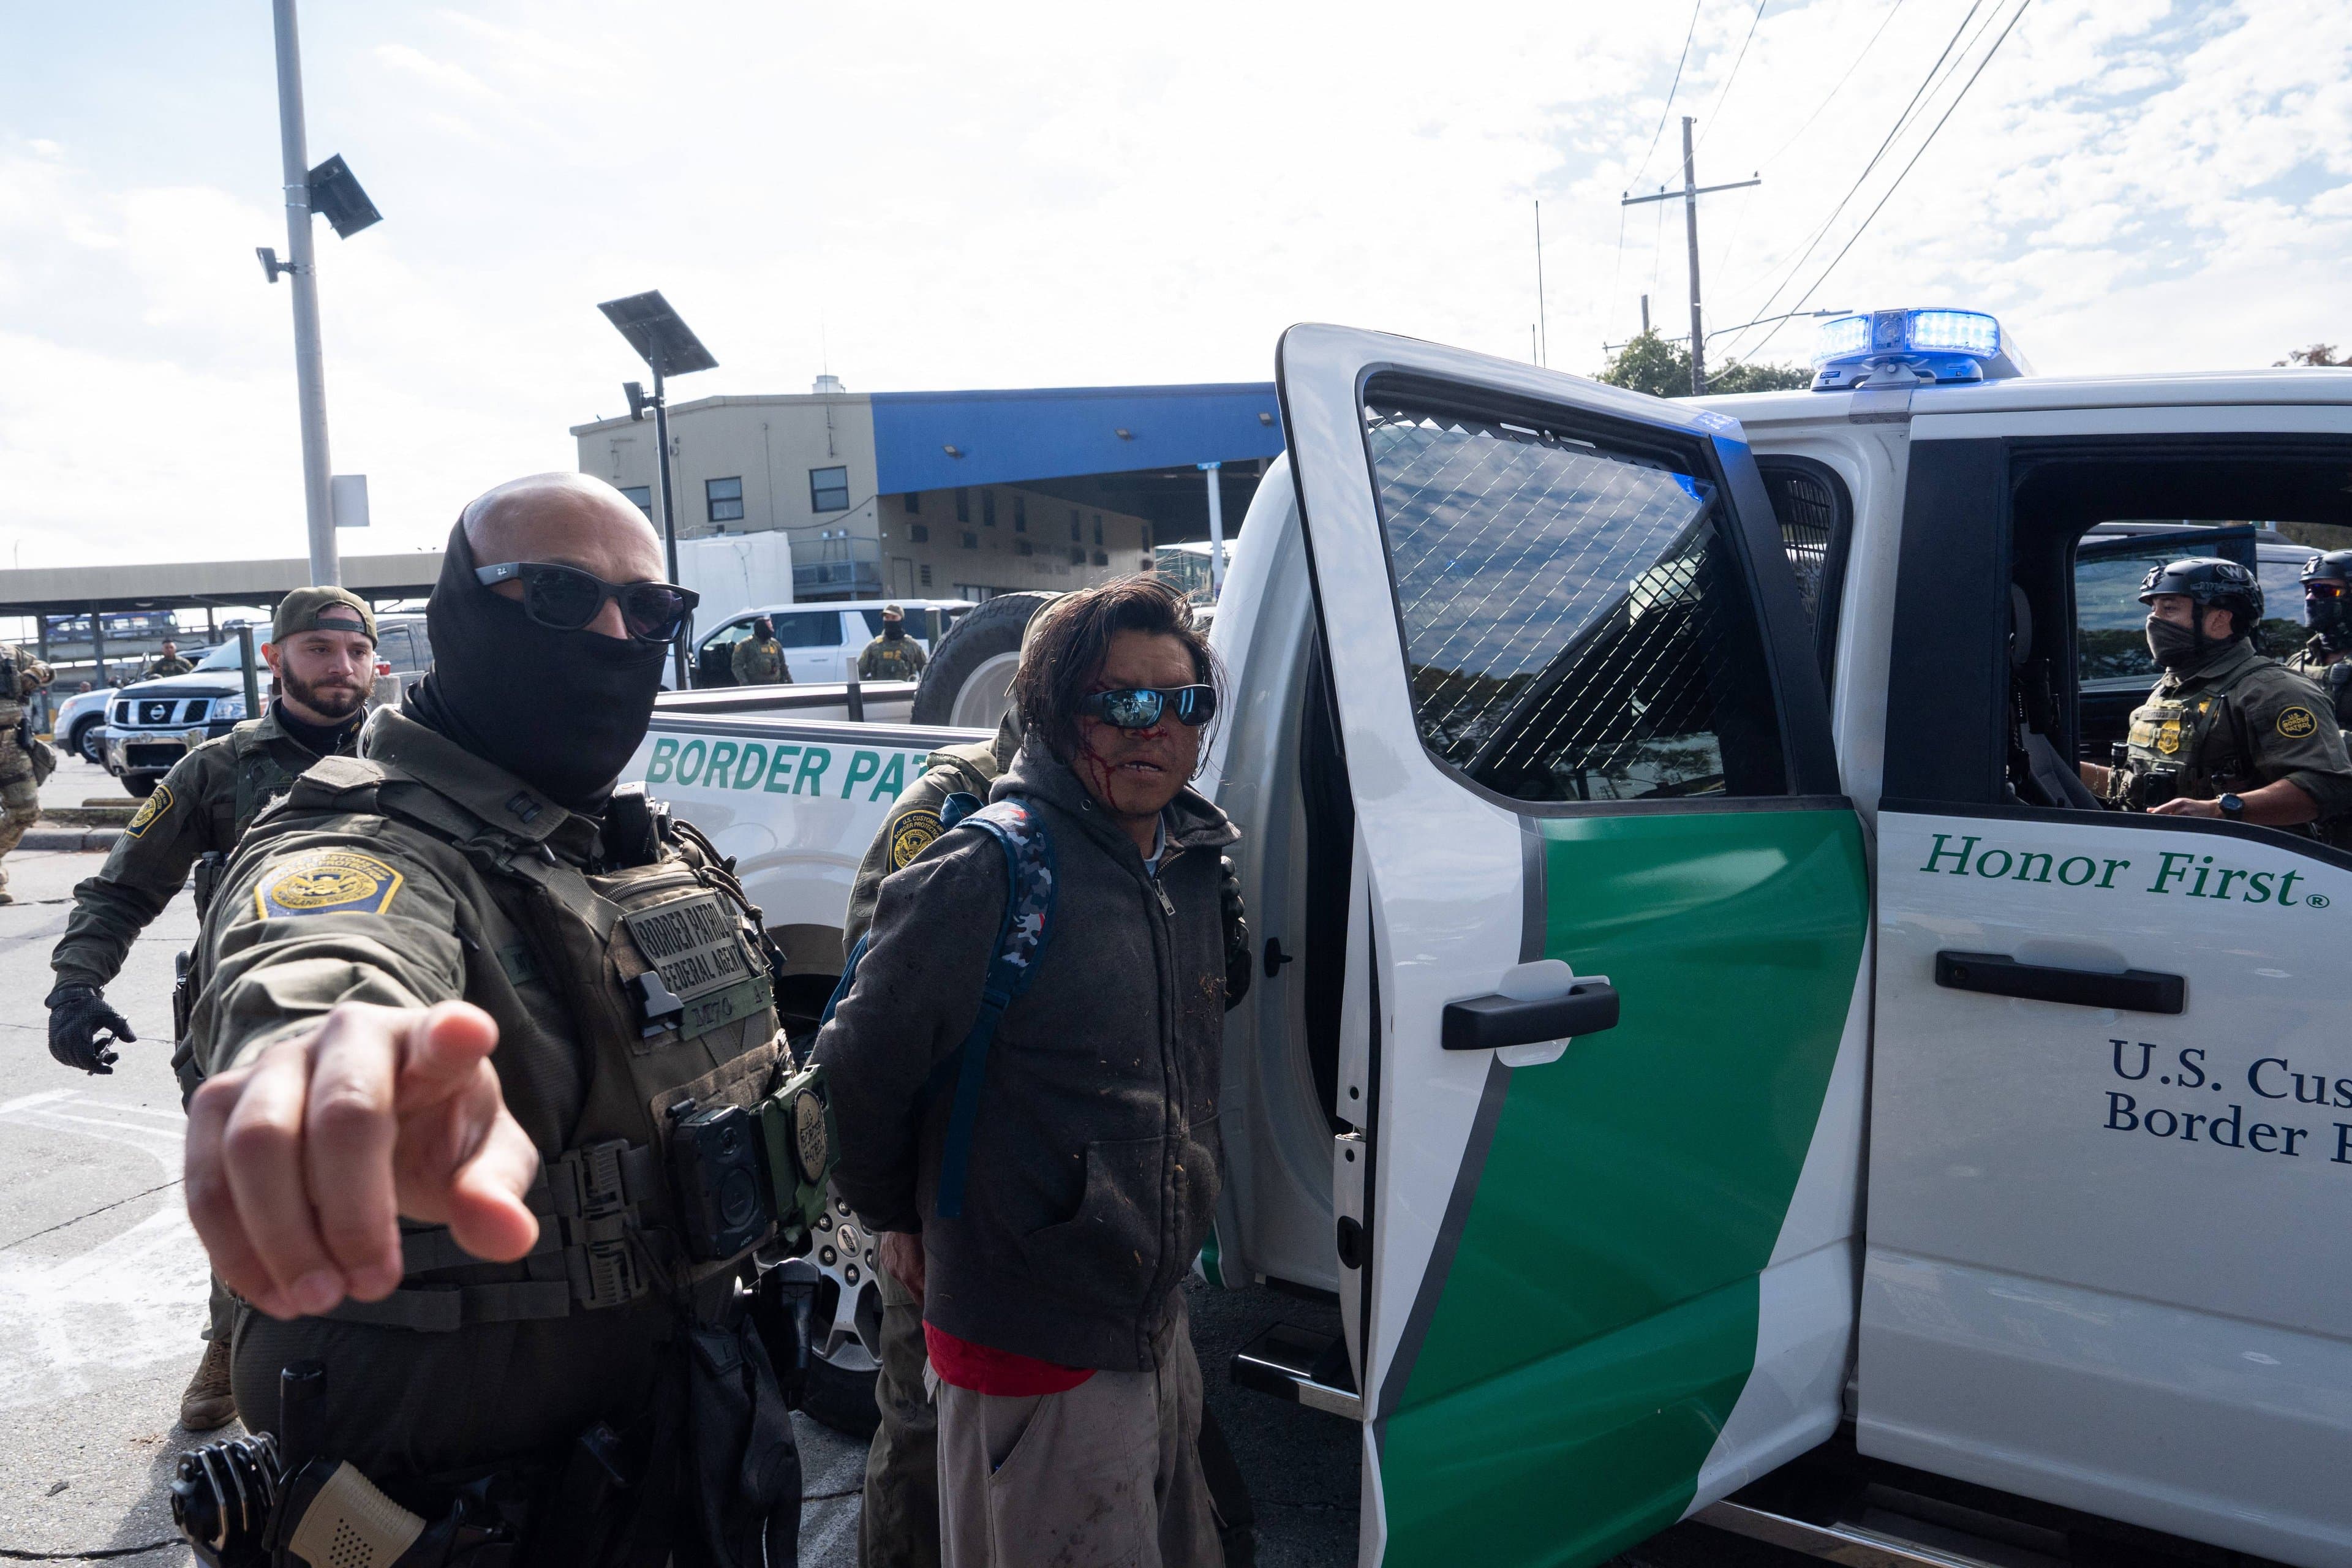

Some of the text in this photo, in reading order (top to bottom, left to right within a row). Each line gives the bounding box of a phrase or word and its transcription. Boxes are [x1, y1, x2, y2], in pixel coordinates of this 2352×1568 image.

[645, 738, 832, 797] BORDER
[894, 821, 940, 839] BORDER PROTECTIO
[913, 815, 938, 827] CUSTOMS
[1920, 834, 2131, 889] Honor
[635, 902, 730, 959] BORDER PATROL
[661, 944, 743, 992] FEDERAL AGENT
[2109, 1039, 2222, 1091] U.S.
[2103, 1091, 2309, 1156] Border
